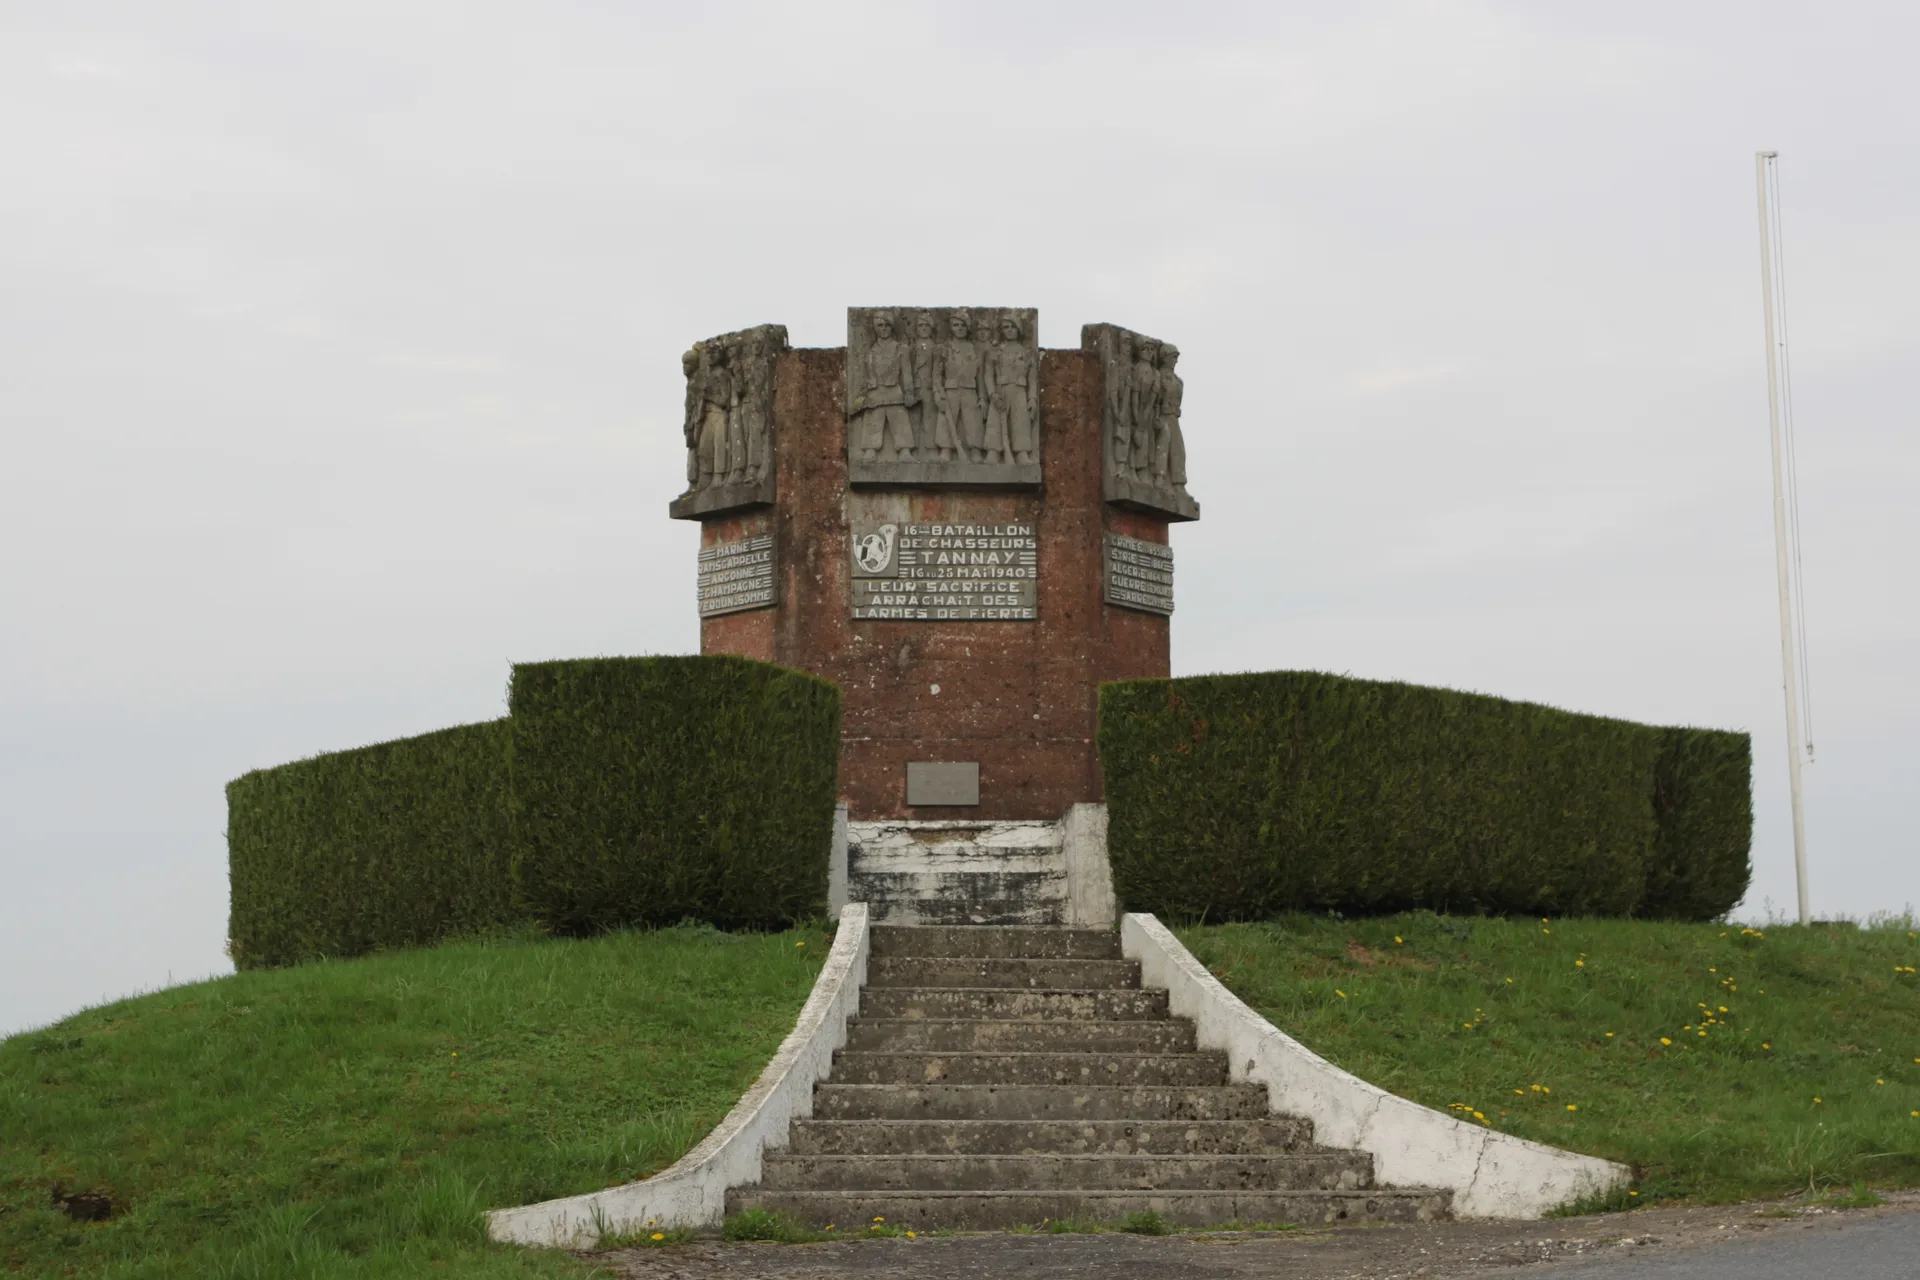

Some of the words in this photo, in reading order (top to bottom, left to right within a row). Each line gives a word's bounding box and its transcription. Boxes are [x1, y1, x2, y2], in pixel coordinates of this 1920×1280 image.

[716, 541, 750, 558] MARNE
[900, 538, 922, 548] DE
[929, 538, 1036, 549] CHASSEURS
[698, 550, 770, 575] RAMSCAPPELLE
[921, 551, 1014, 564] TANNAY
[710, 566, 755, 585] ARGONNE
[911, 567, 924, 578] 16
[938, 567, 953, 578] 25
[991, 567, 1025, 578] 1940
[704, 578, 762, 598] CHAMPAGNE
[868, 581, 916, 592] LEUR
[1111, 575, 1147, 592] GUERRE
[983, 595, 1018, 606] DES
[1120, 590, 1148, 605] SARRE
[855, 608, 928, 619] LARMES
[937, 608, 959, 618] DE
